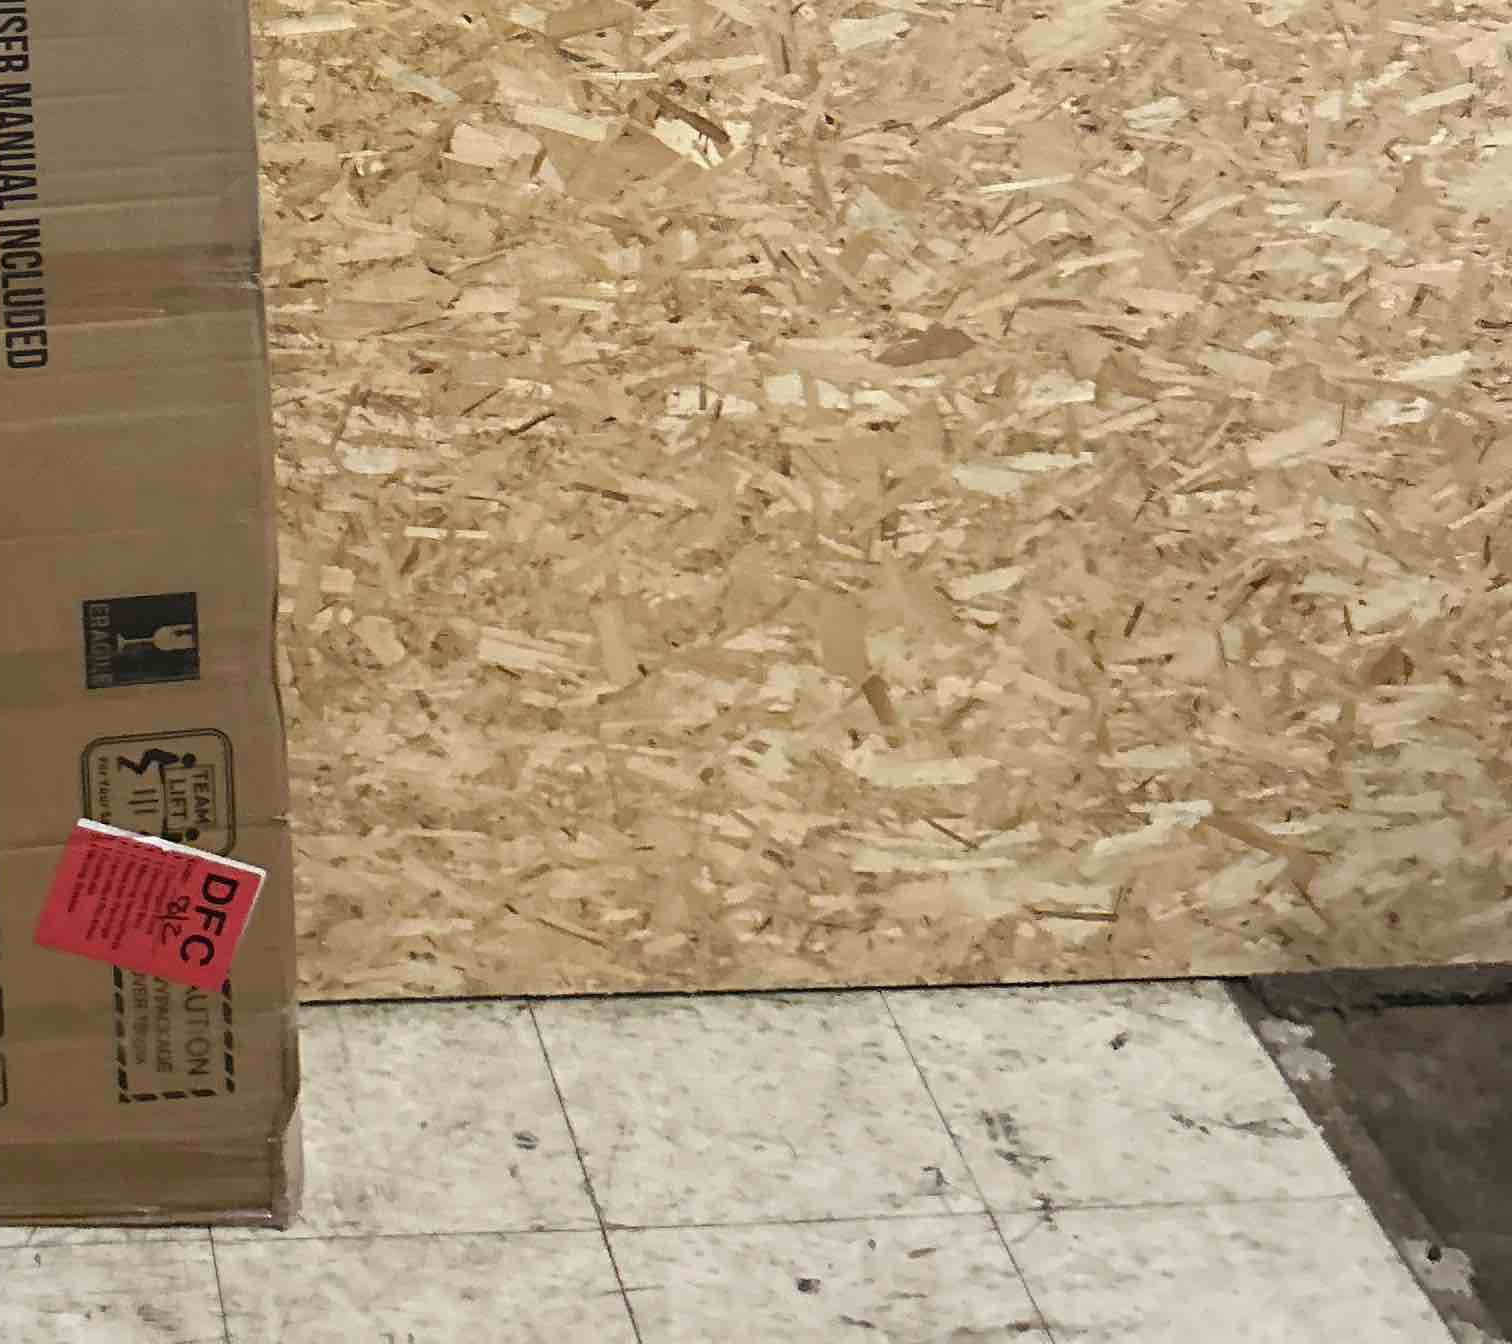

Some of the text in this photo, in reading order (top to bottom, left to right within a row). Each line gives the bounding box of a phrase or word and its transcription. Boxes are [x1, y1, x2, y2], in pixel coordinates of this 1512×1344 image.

[0, 218, 49, 369] INCLUDED
[168, 779, 188, 820] LIFT
[192, 768, 211, 825] TEAM
[180, 873, 239, 967] DFC
[184, 986, 210, 1075] UTION
